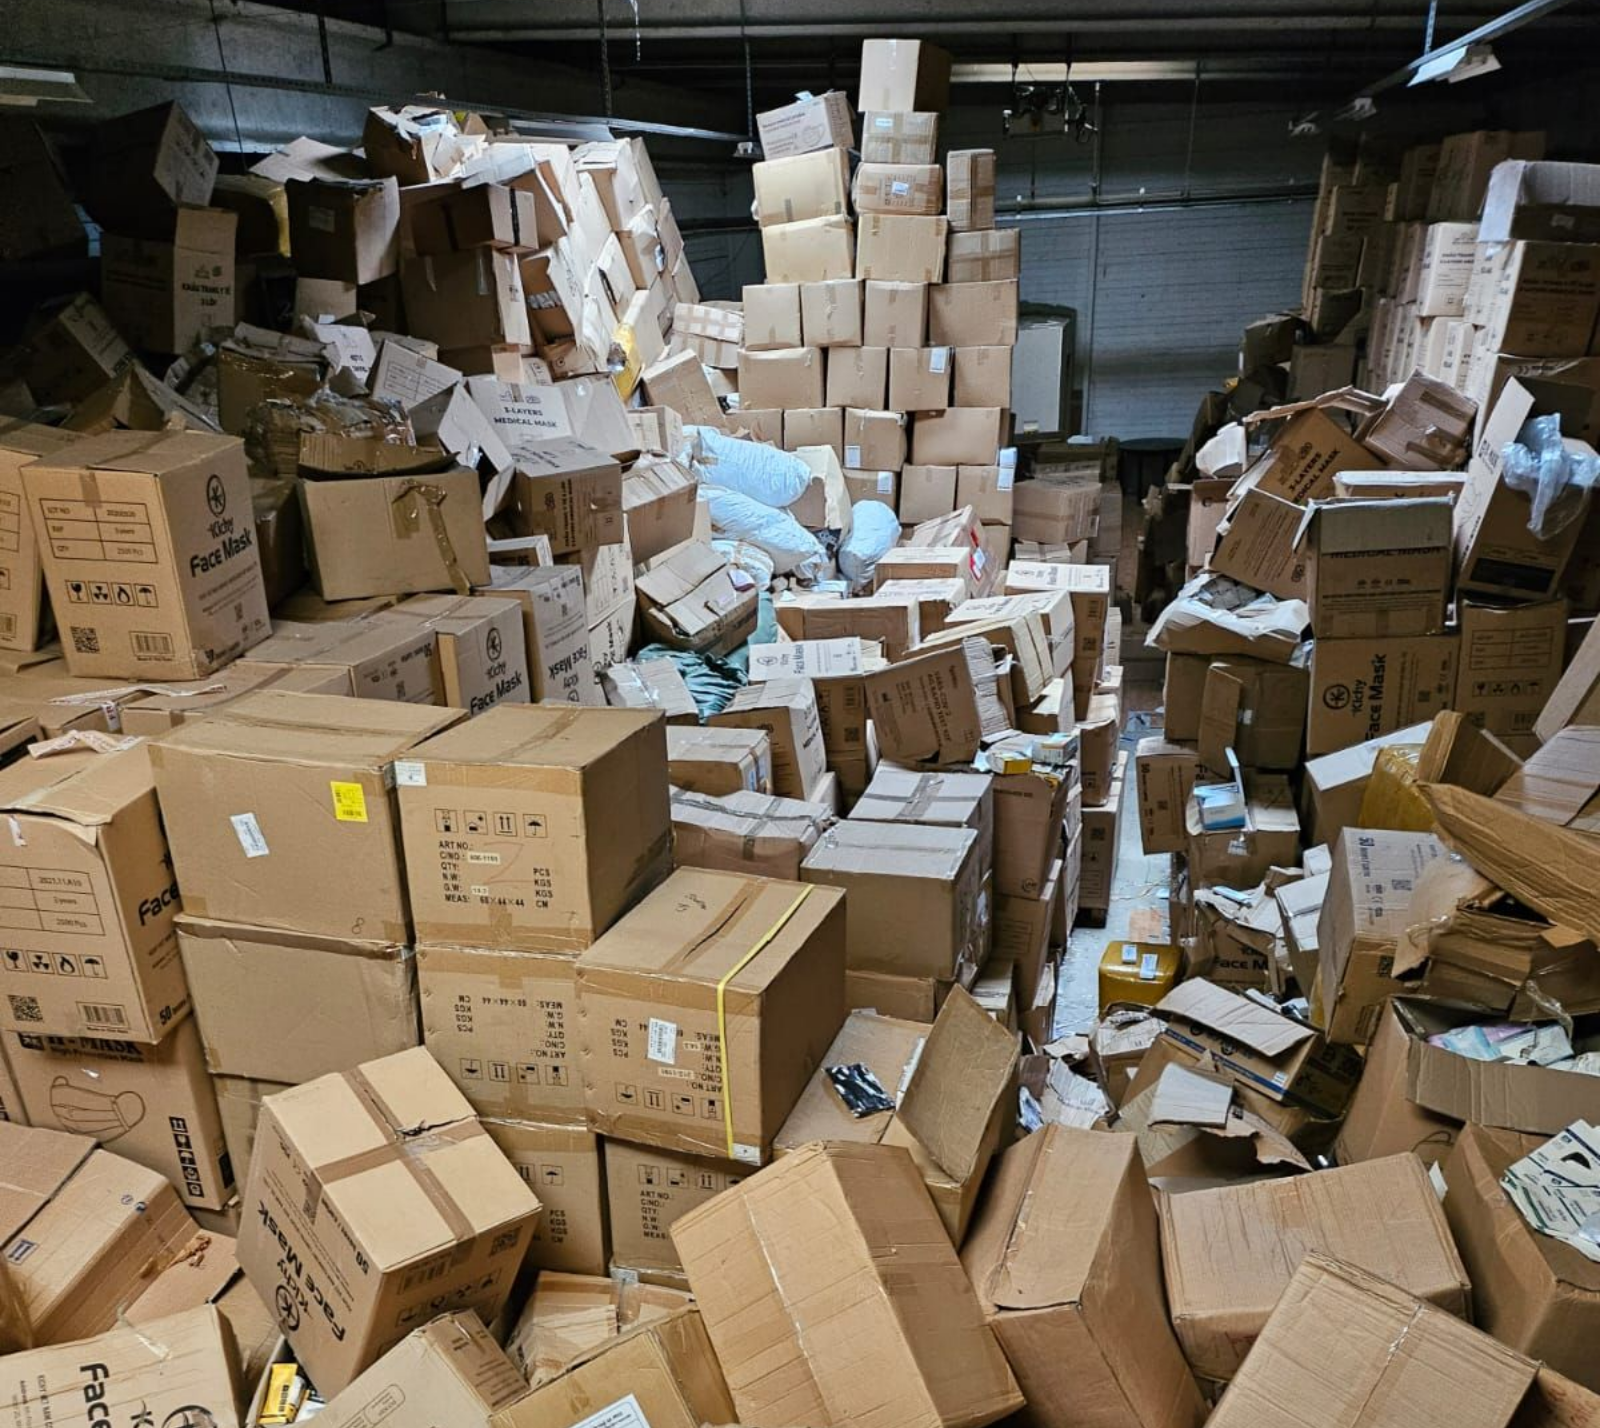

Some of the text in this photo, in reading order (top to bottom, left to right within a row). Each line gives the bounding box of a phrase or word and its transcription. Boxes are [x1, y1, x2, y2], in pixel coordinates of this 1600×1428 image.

[493, 416, 533, 425] MEDICAL
[190, 527, 253, 578] Face Mask
[548, 643, 588, 680] Face Mask
[470, 670, 523, 715] Face Mask
[1365, 653, 1387, 740] Face Mask
[1351, 679, 1367, 716] Kichy
[438, 841, 456, 849] ART
[441, 863, 460, 871] QTY:
[533, 868, 550, 877] PCS
[534, 879, 552, 888] KGS
[535, 890, 553, 899] KGS
[138, 882, 180, 926] Face
[445, 894, 471, 903] MEAS:
[536, 900, 549, 908] CM
[458, 995, 471, 1003] CM
[455, 1004, 472, 1012] KGS
[537, 1000, 563, 1009] MEAS:
[159, 1006, 173, 1026] 50
[456, 1014, 473, 1023] KGS
[615, 1019, 627, 1028] CM
[458, 1024, 473, 1033] PCS
[610, 1028, 628, 1037] KGS
[612, 1038, 629, 1047] KGS
[550, 1051, 566, 1059] ART
[613, 1049, 629, 1058] PCS
[704, 1084, 723, 1093] ART
[550, 1210, 566, 1218] PCS
[550, 1219, 567, 1227] KGS
[551, 1228, 568, 1236] KGS
[258, 1202, 303, 1277] Mask
[355, 1251, 369, 1275] 50
[304, 1275, 347, 1342] Face
